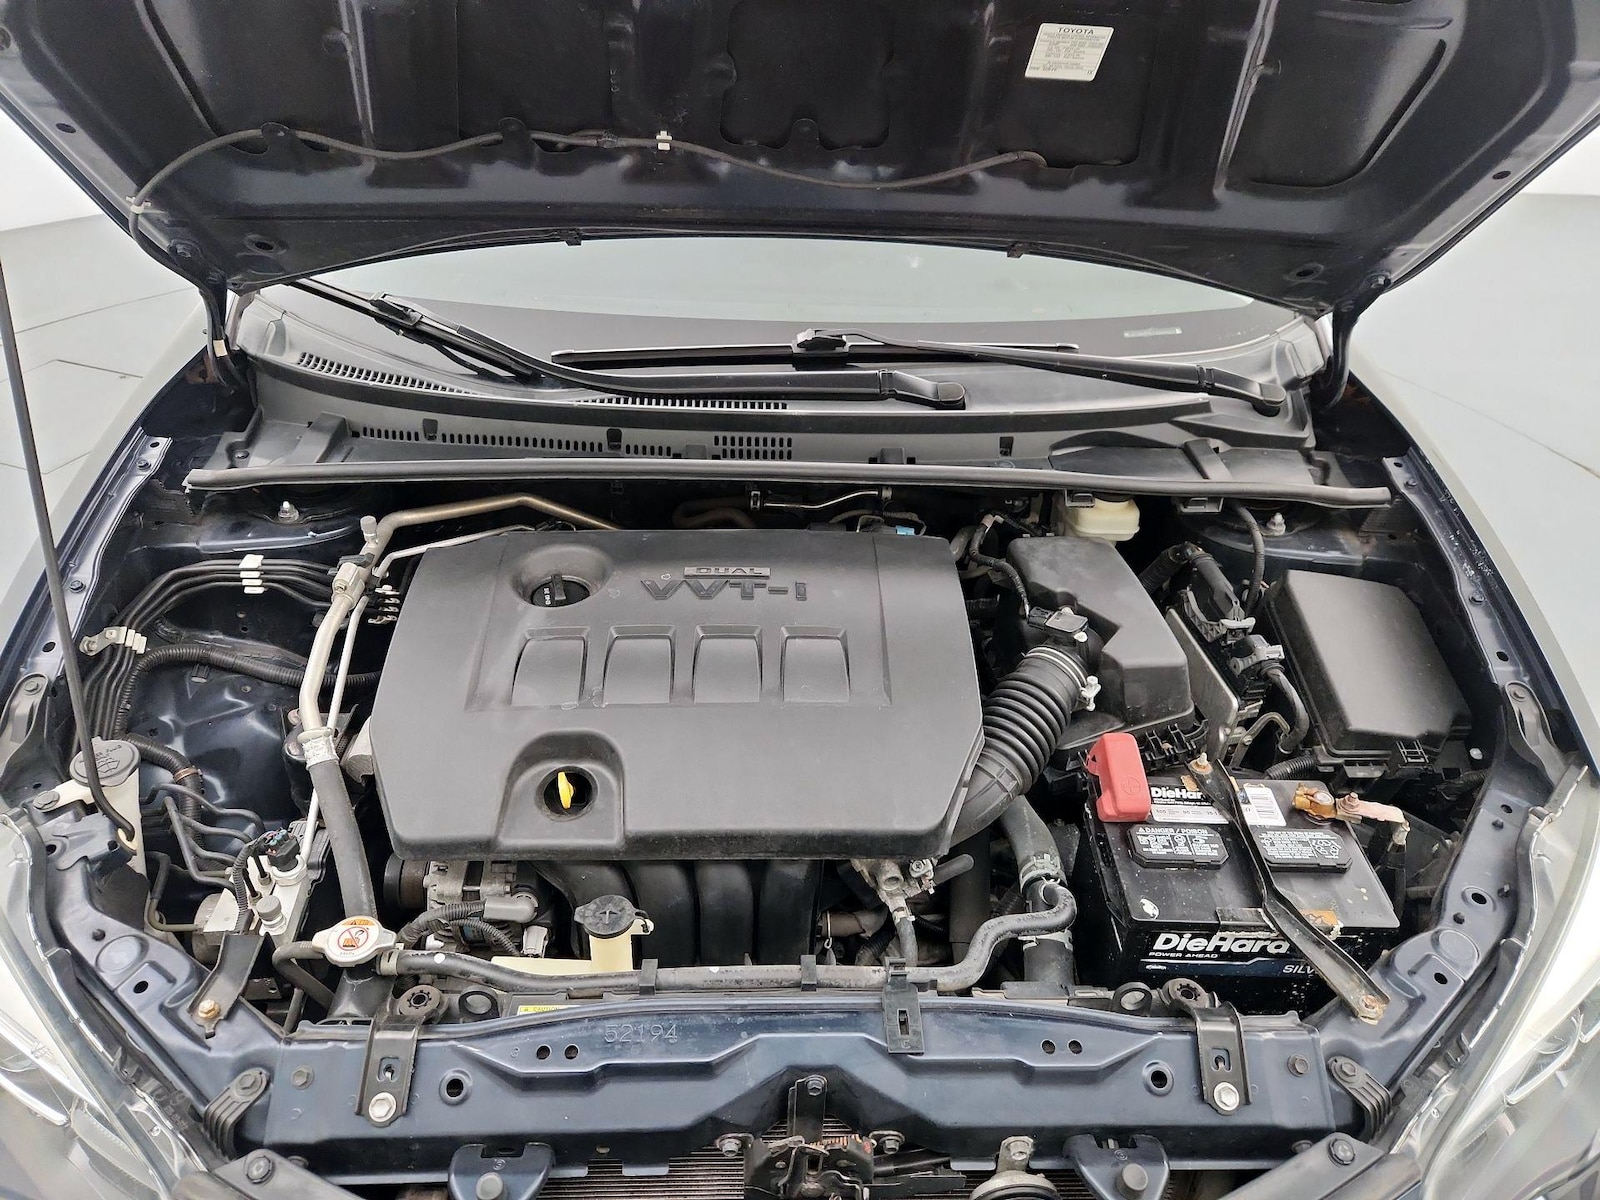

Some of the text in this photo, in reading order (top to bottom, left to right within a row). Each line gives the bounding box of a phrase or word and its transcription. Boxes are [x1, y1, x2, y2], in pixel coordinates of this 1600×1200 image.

[1057, 27, 1094, 35] TOYOTA
[695, 567, 763, 575] DUAL
[1150, 786, 1207, 800] DieHar
[1282, 964, 1315, 975] SILV
[603, 1024, 678, 1043] 52194
